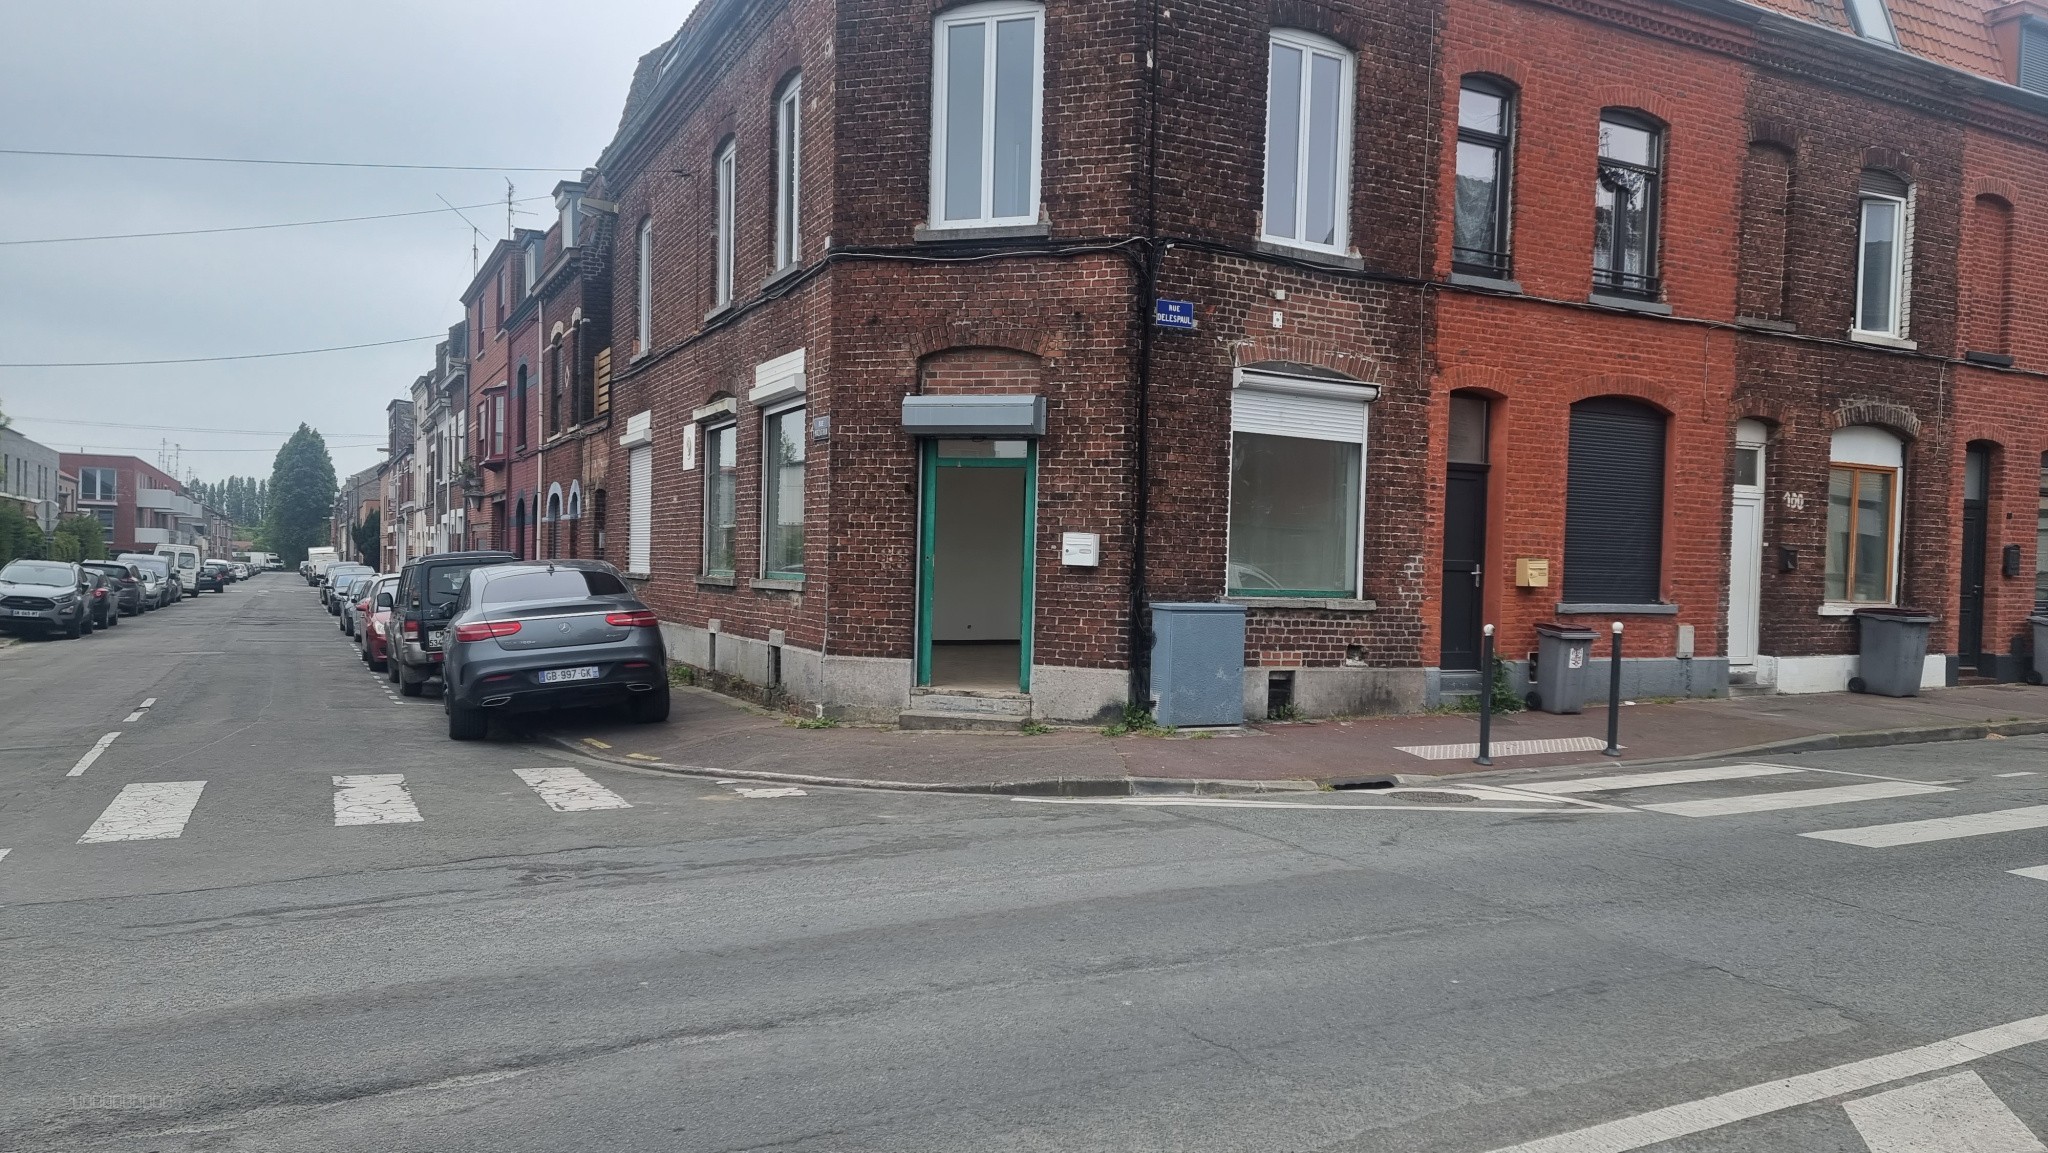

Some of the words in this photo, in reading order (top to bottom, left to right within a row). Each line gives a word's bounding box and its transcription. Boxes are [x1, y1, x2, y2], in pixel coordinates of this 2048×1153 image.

[1168, 304, 1181, 312] RUE
[1157, 313, 1192, 324] DELESPAUL
[1783, 491, 1804, 510] 100
